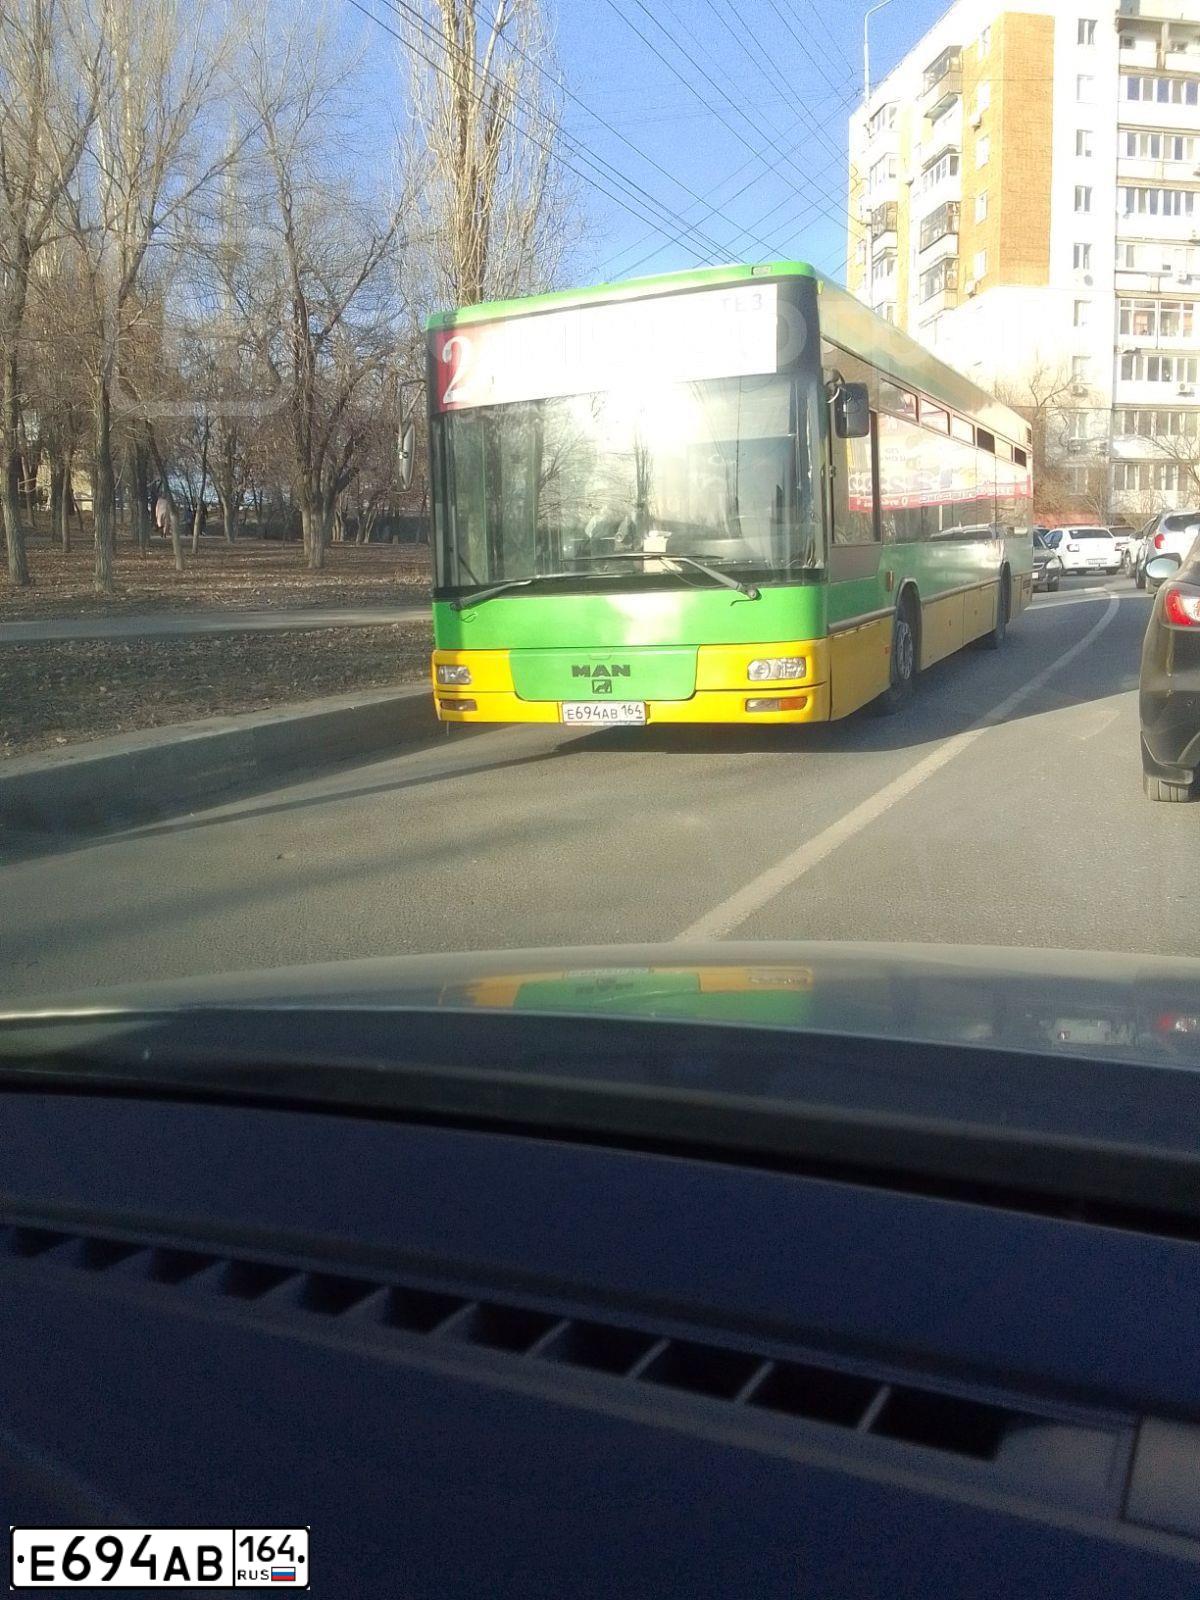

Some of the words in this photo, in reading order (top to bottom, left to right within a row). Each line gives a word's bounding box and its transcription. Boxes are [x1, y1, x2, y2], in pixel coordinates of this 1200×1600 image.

[571, 664, 631, 678] MAN
[566, 705, 618, 720] Е694АВ
[621, 704, 643, 715] 164
